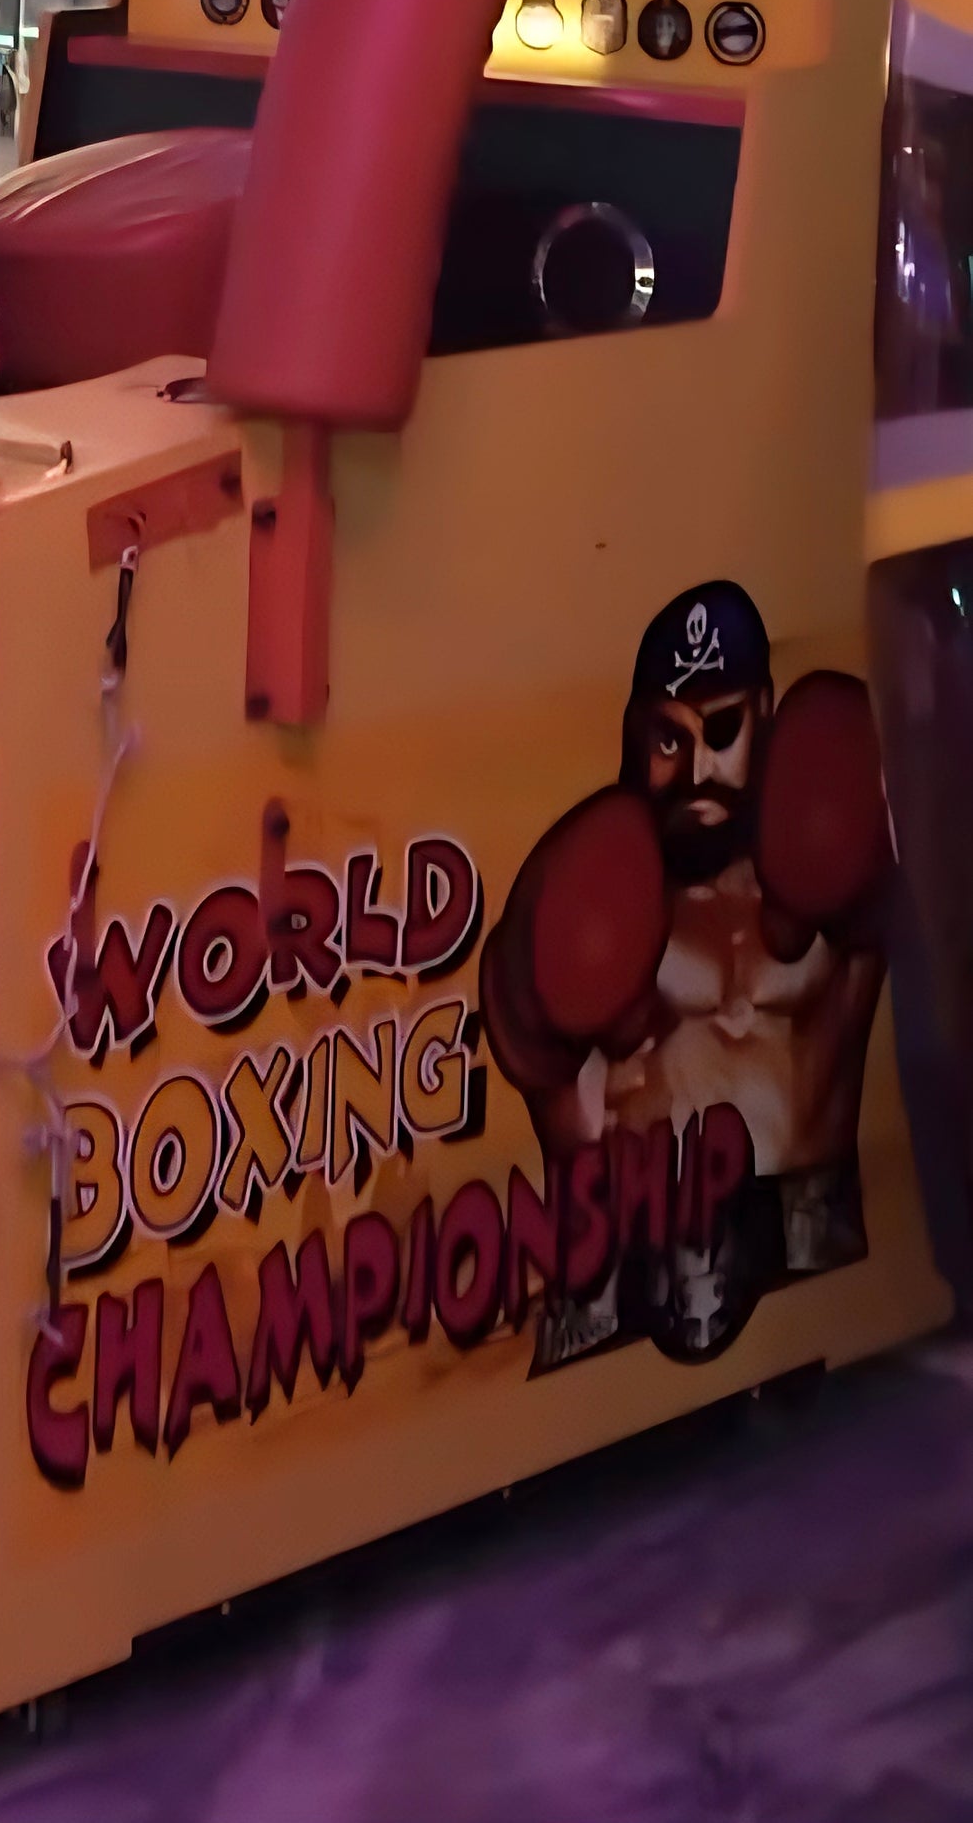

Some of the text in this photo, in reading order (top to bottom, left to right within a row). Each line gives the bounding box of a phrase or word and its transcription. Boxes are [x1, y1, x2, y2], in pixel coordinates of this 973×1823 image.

[47, 836, 483, 1066] WORLD
[59, 1000, 485, 1278] BOXING
[27, 1100, 756, 1490] CHAMPIONSHIP
